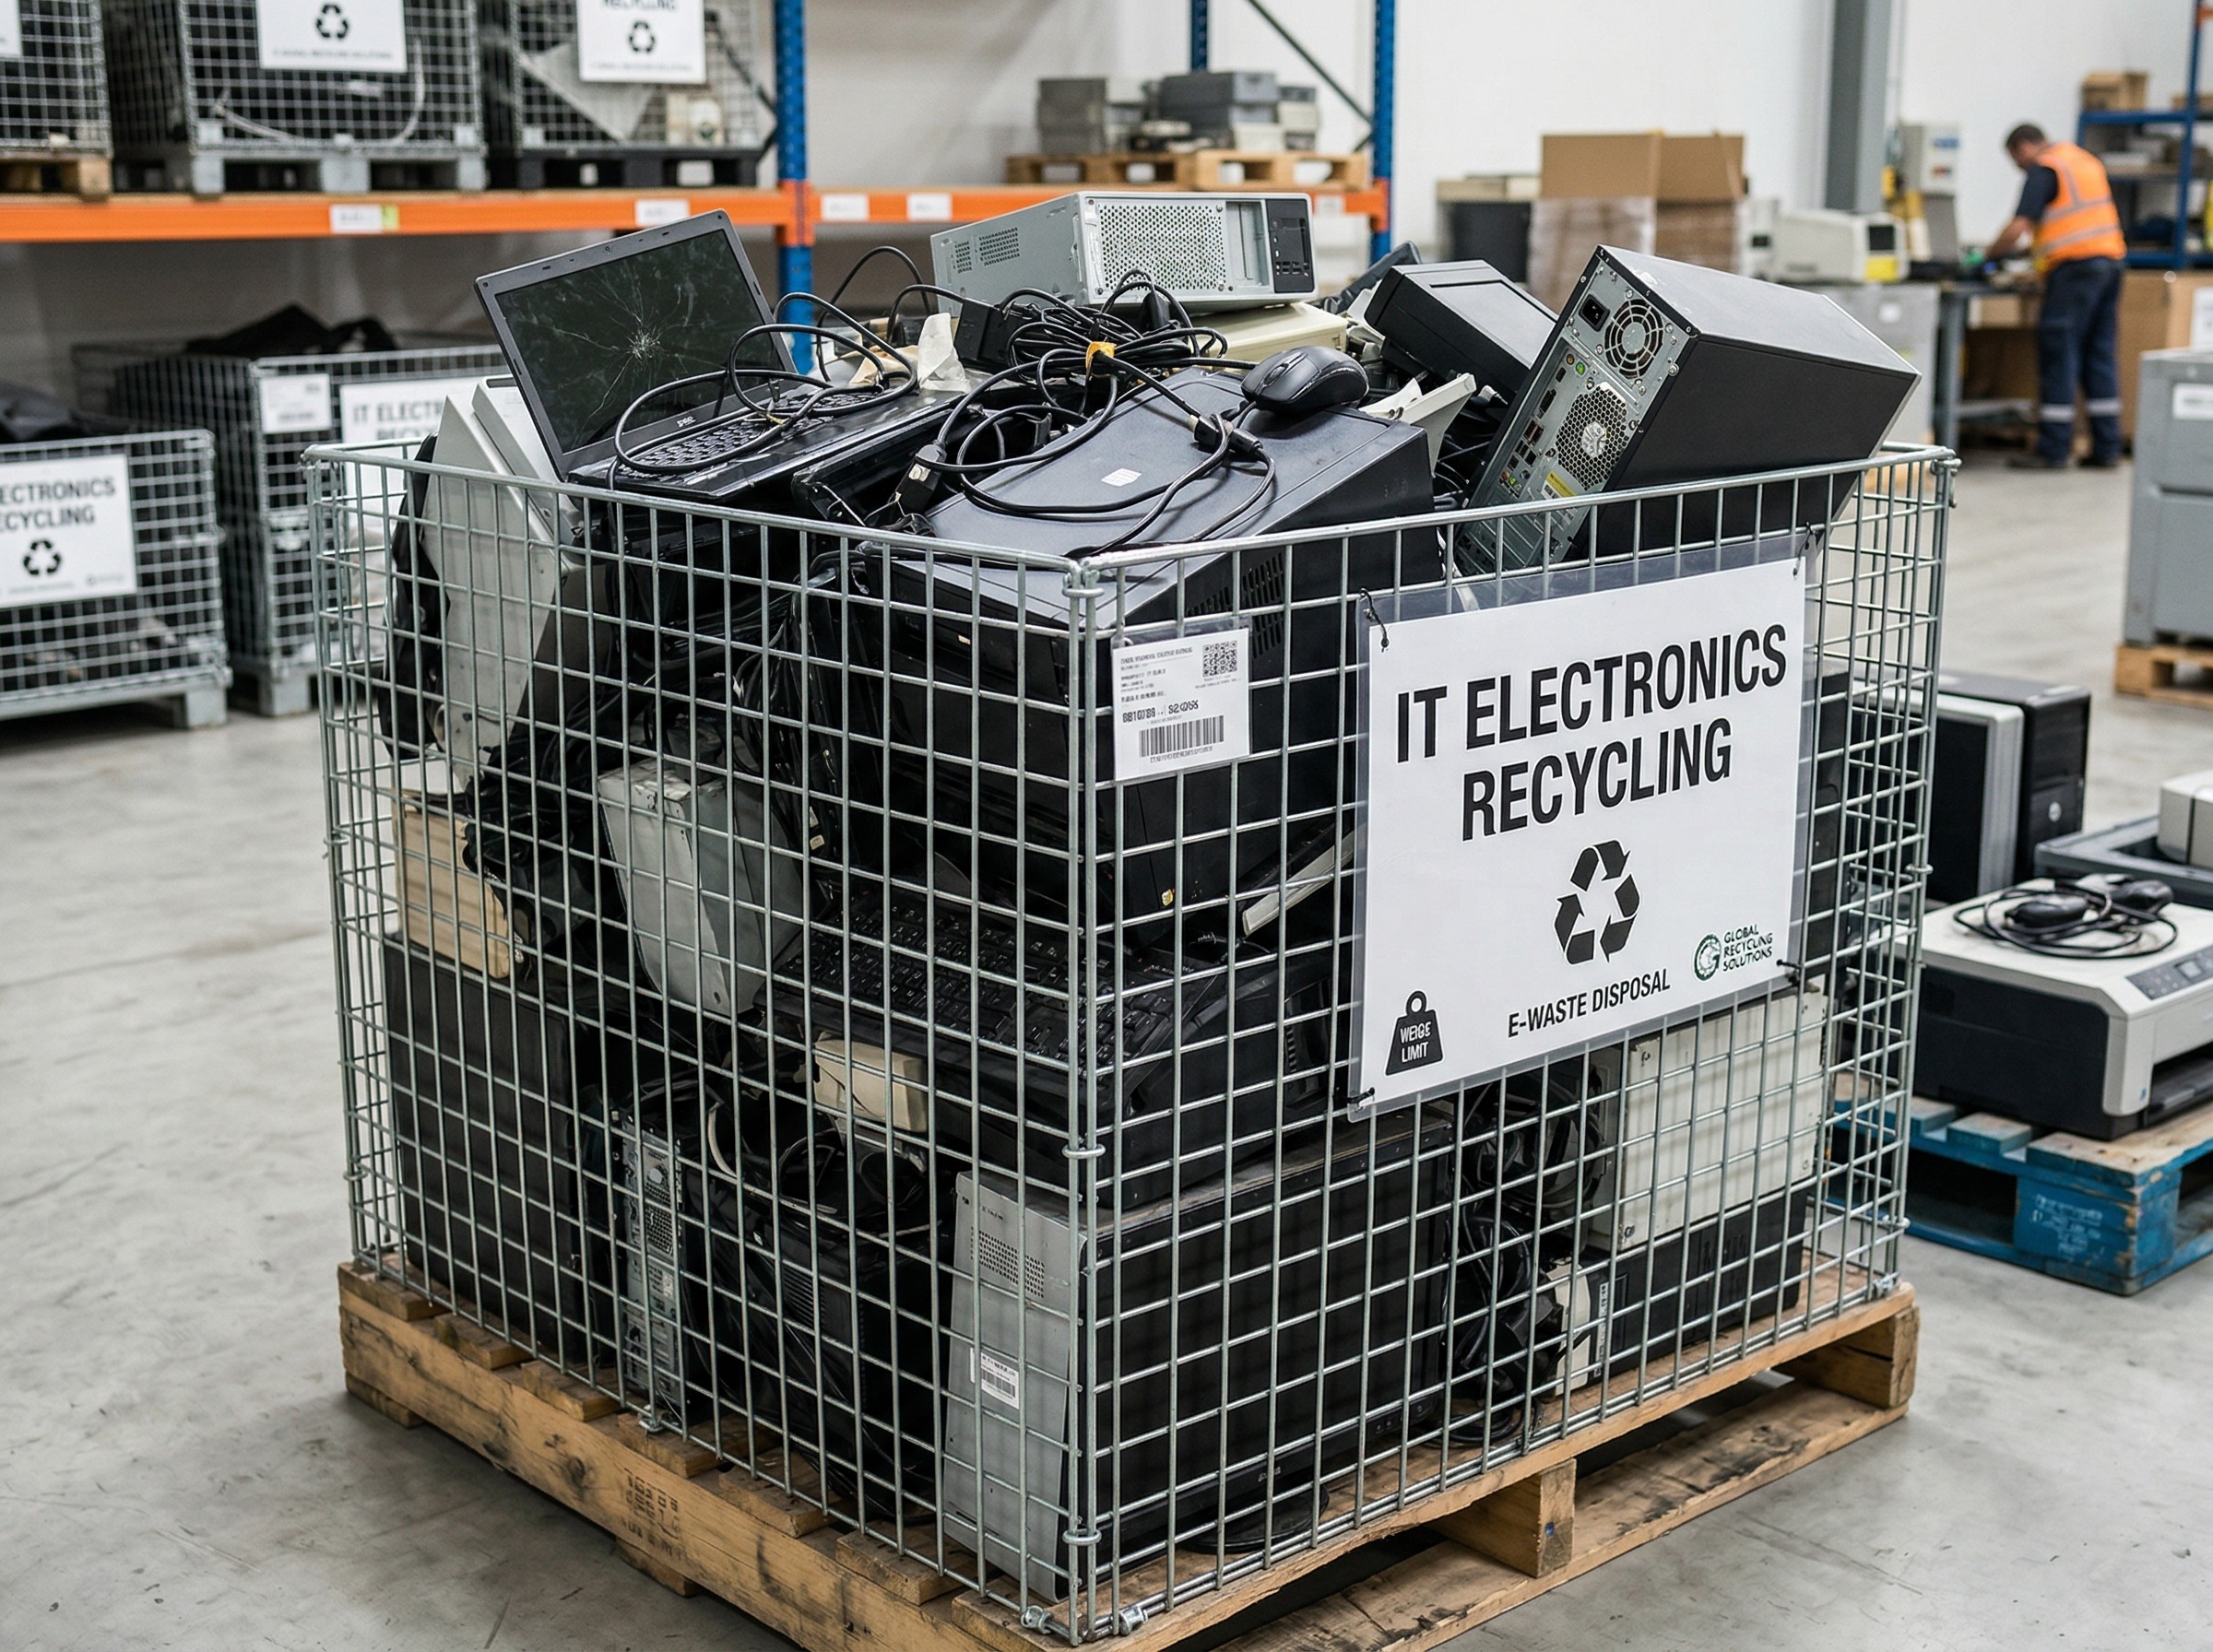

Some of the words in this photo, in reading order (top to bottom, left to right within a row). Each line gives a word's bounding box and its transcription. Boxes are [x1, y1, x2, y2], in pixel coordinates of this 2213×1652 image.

[1396, 685, 1448, 763] IT
[1466, 624, 1787, 751] ELECTRONICS
[1462, 717, 1733, 842] RECYCLING
[1723, 924, 1759, 944] GLOBAL
[1722, 946, 1772, 972] SOLUTIONS
[1508, 992, 1588, 1038] E-WASTE
[1592, 968, 1672, 1012] DISPOSAL
[1402, 1041, 1429, 1063] LIMIT
